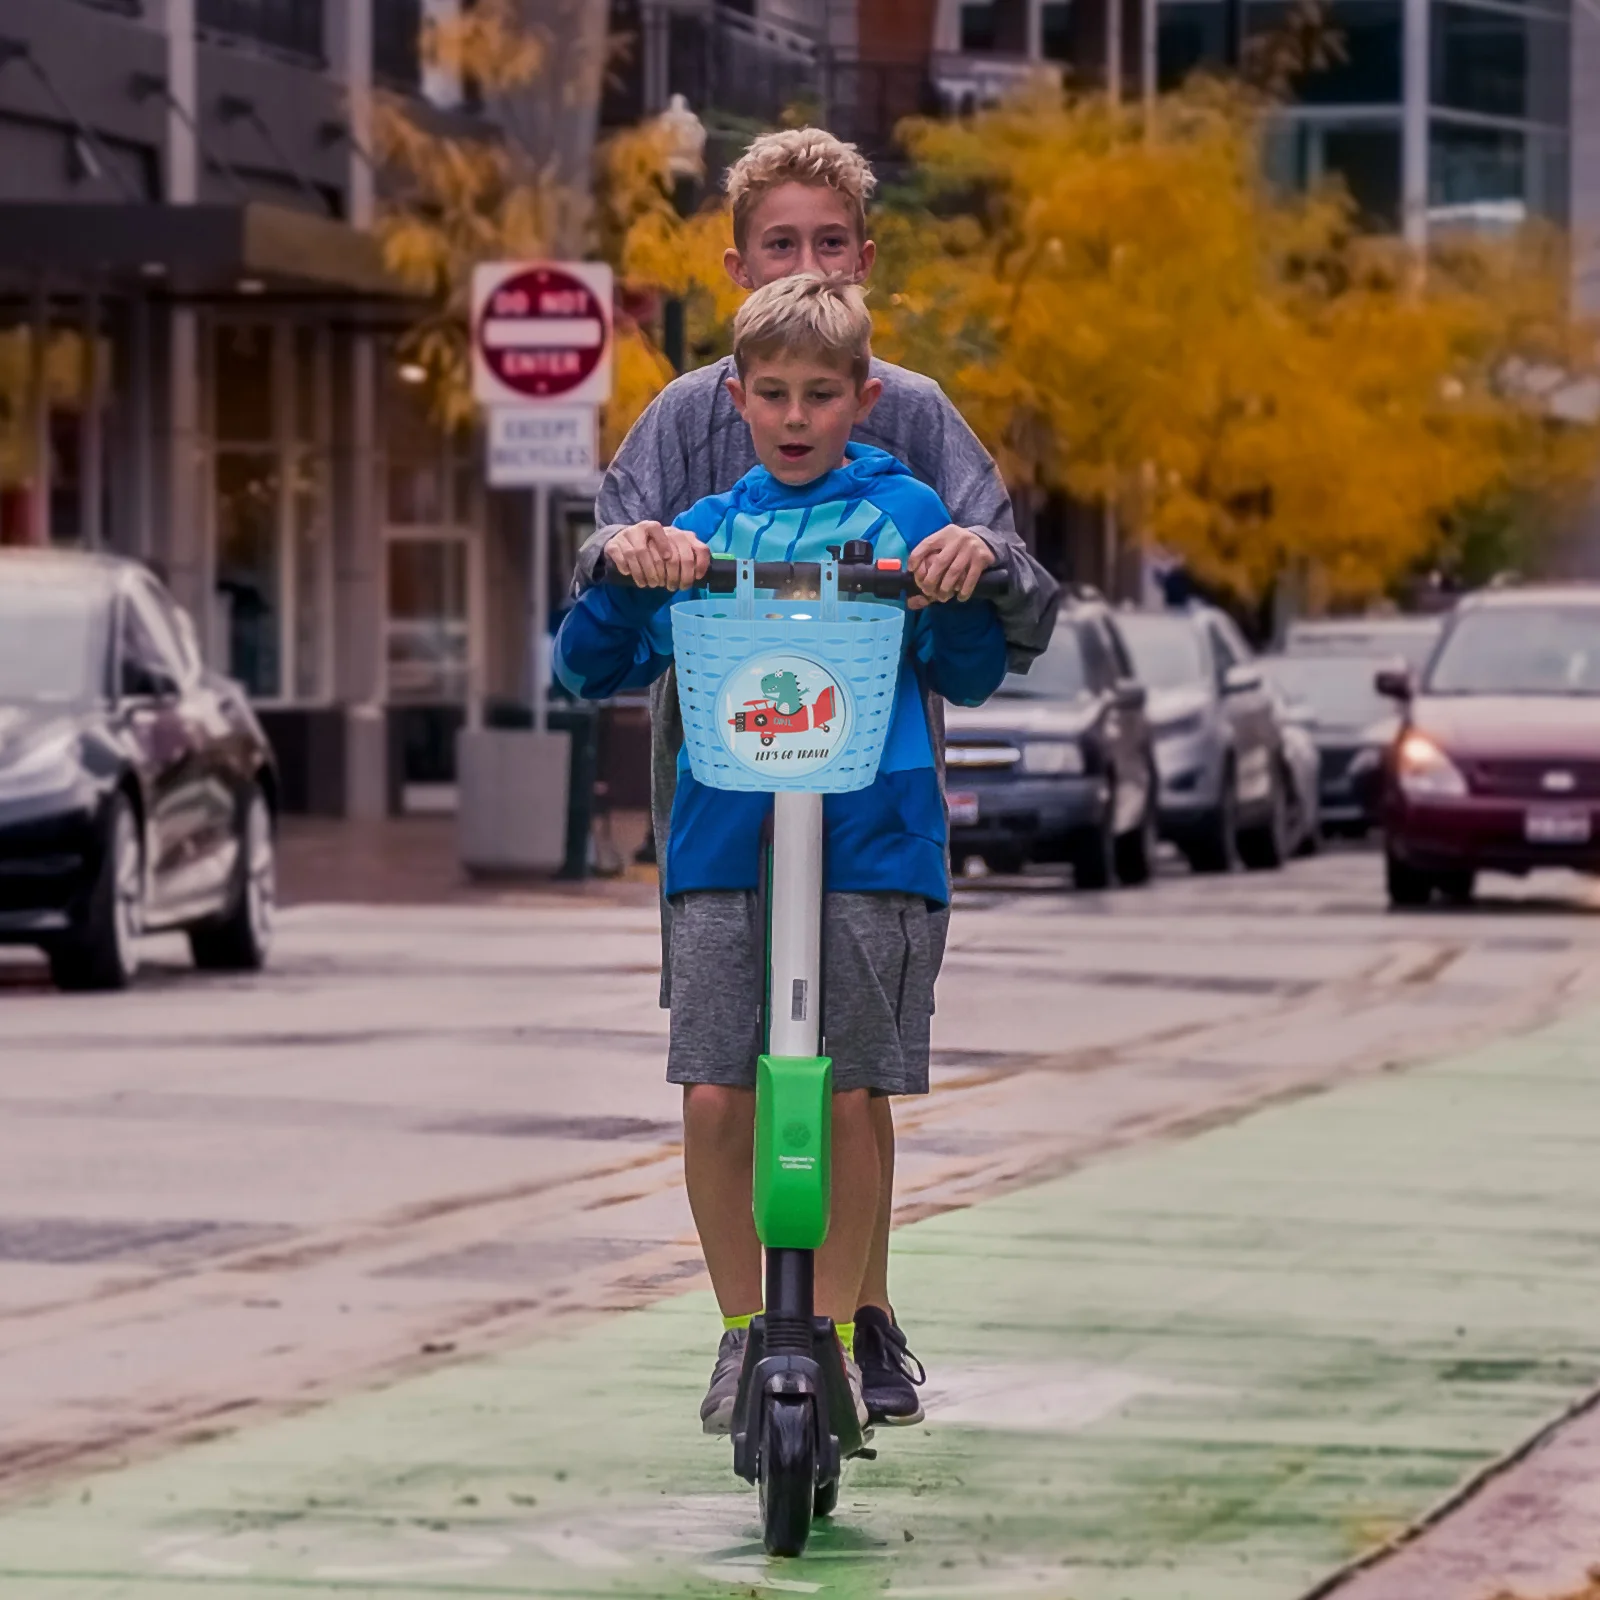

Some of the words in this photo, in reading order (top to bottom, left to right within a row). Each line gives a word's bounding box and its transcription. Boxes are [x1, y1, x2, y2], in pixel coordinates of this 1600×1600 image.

[494, 290, 529, 314] DO
[539, 290, 587, 314] NOT
[502, 352, 580, 375] ENTER
[504, 419, 577, 440] EXCEPT
[755, 750, 779, 761] LET'S
[781, 749, 794, 760] GO
[797, 748, 829, 759] TRAVEL
